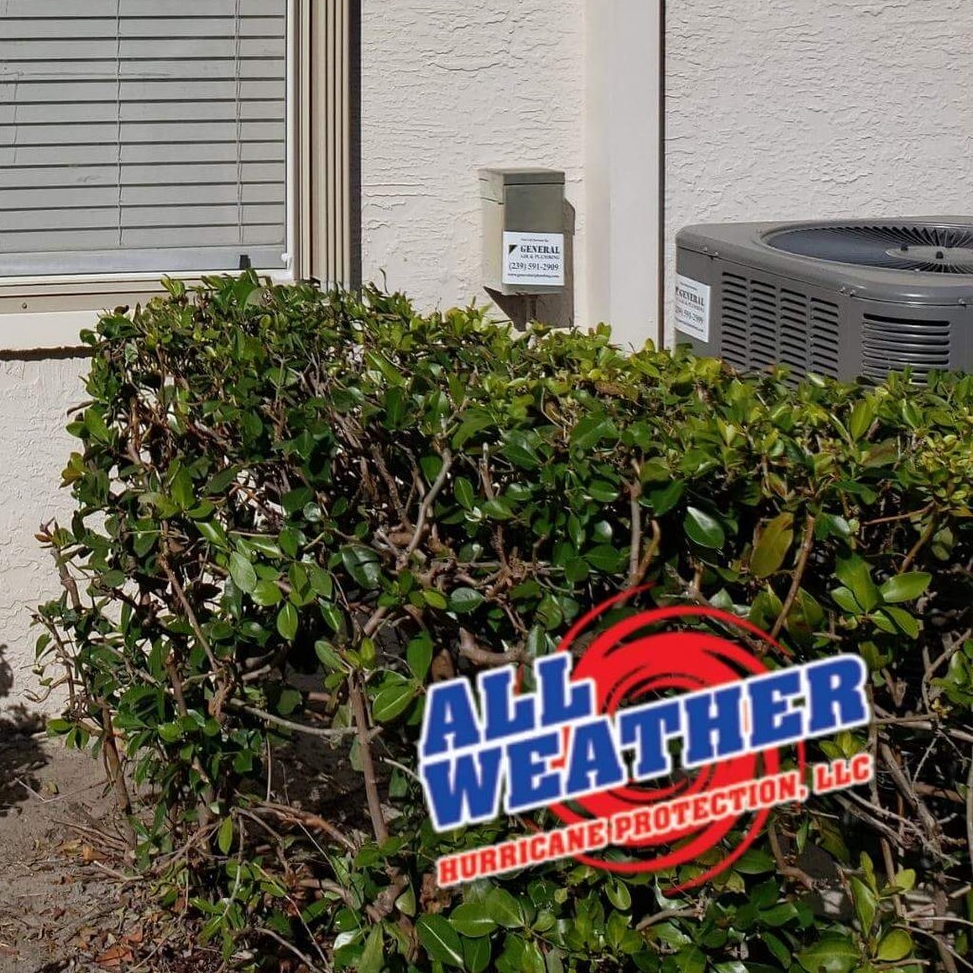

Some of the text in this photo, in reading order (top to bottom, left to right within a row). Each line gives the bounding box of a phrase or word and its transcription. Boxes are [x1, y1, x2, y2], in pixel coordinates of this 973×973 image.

[520, 245, 560, 254] GENERAL
[508, 262, 559, 271] (239) 591-2909
